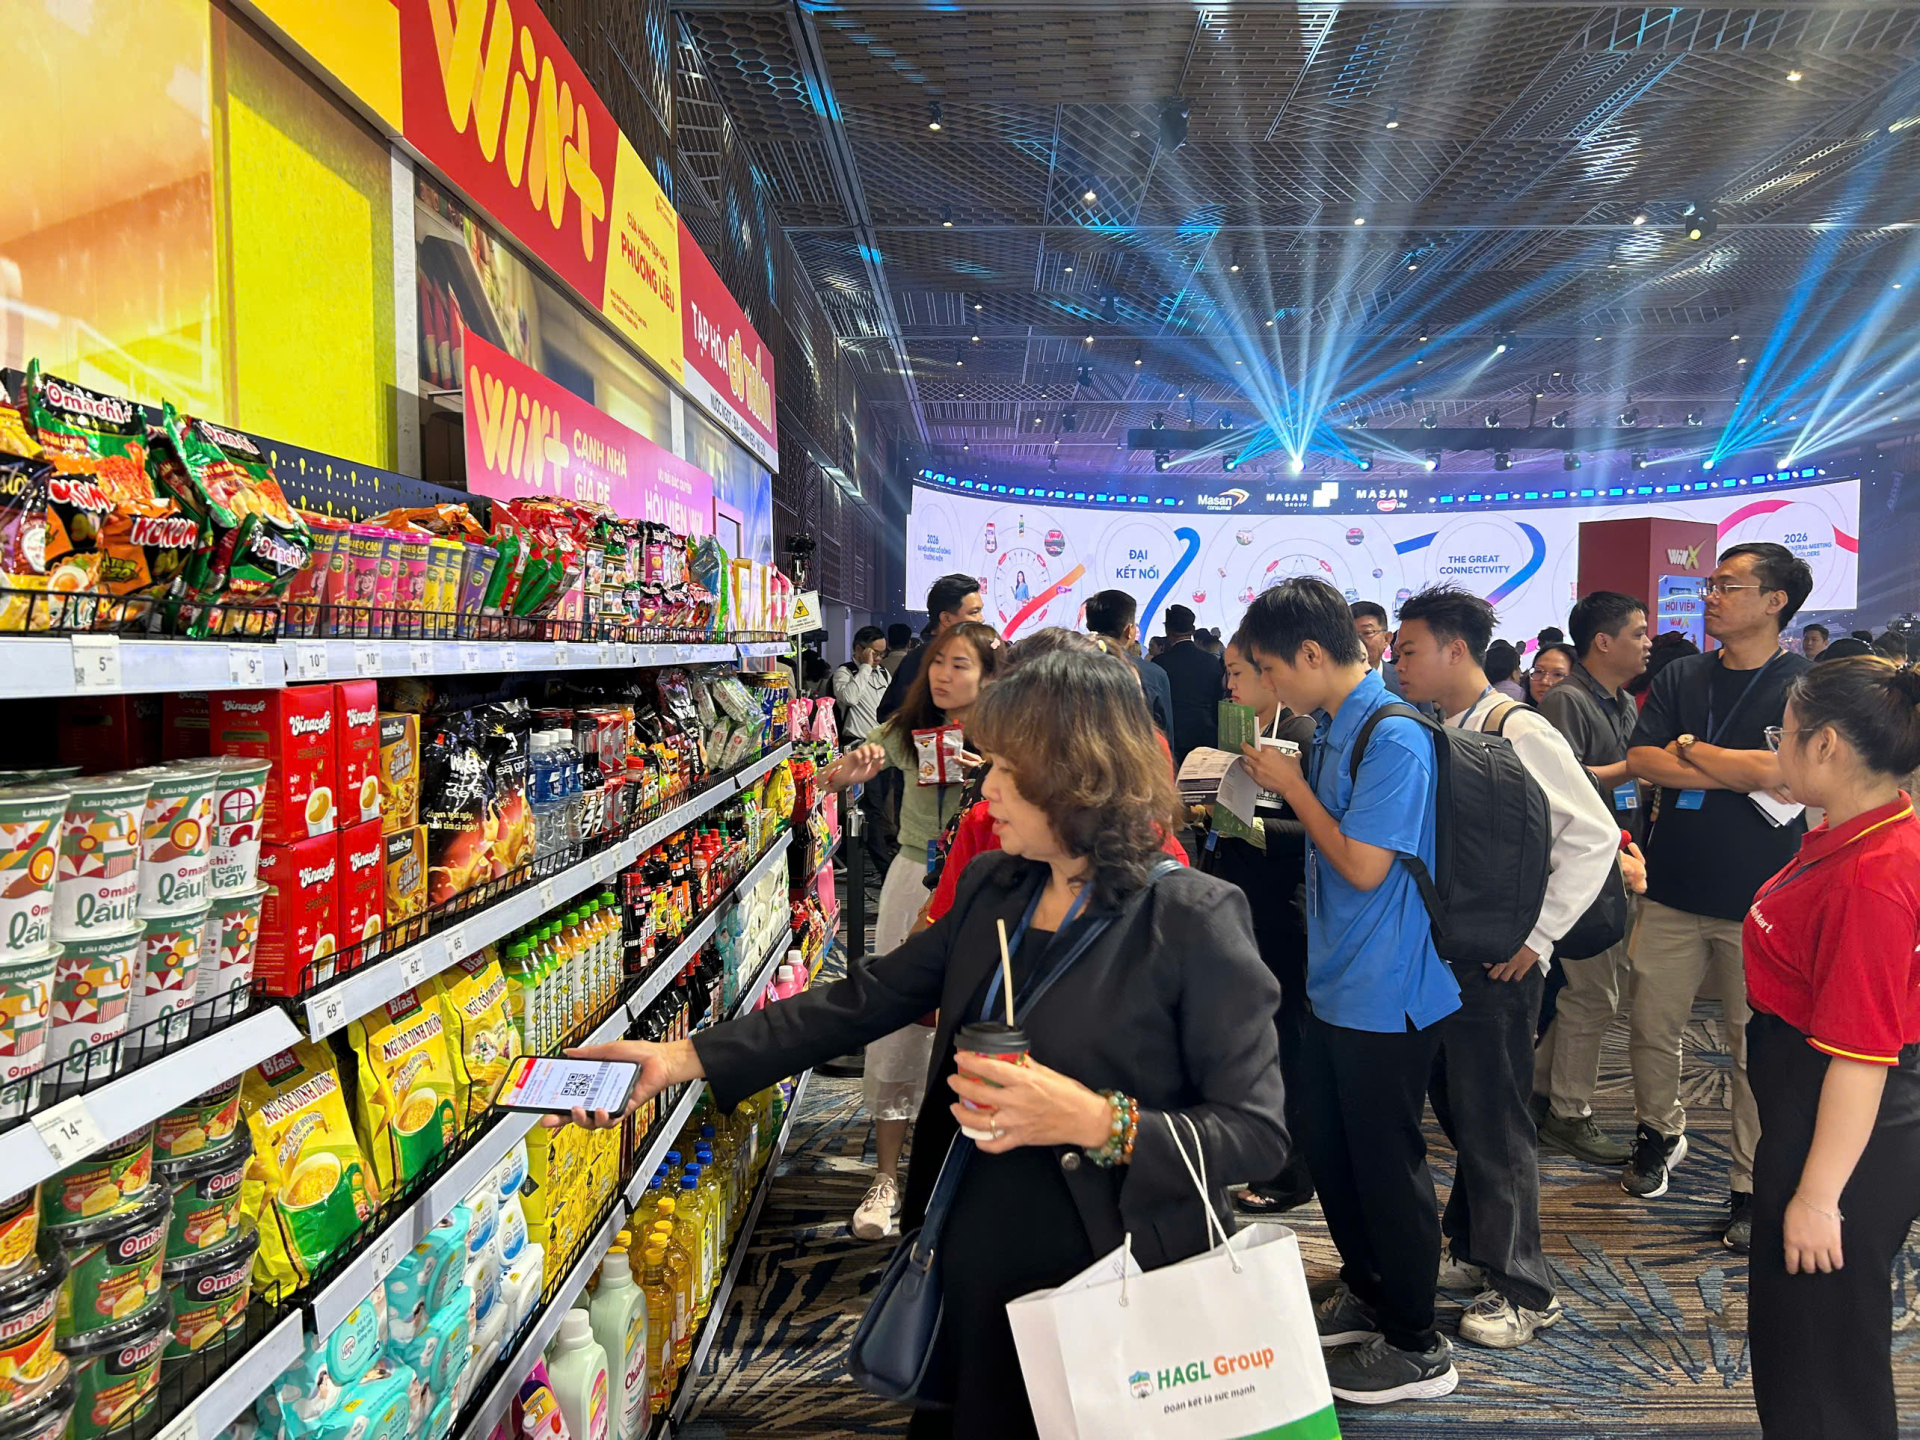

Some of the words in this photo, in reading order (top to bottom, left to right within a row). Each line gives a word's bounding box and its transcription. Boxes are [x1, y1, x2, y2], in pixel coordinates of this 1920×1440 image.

[691, 300, 708, 357] TẠP
[710, 323, 728, 377] HÓA
[47, 382, 125, 424] Omachi
[1198, 494, 1232, 506] Masan
[1356, 490, 1408, 499] MASAN
[1784, 533, 1808, 544] 2026
[1128, 549, 1148, 562] ĐẠI
[1448, 555, 1466, 564] THE
[1468, 554, 1500, 564] GREAT
[1116, 564, 1136, 579] KẾT
[1138, 564, 1160, 580] NỐI
[1440, 564, 1510, 575] CONNECTIVITY
[99, 656, 106, 671] 5
[250, 660, 256, 673] 9
[310, 655, 320, 667] 10
[366, 653, 376, 664] 10
[289, 711, 331, 736] Vinacafé
[347, 704, 376, 728] Vinacafé
[389, 836, 412, 852] wake-up
[350, 844, 380, 872] Vinacafé
[211, 868, 248, 889] tay
[299, 858, 335, 889] Vinacafé
[98, 883, 136, 898] Omach
[157, 873, 201, 906] lẩu
[75, 893, 124, 928] lẩu
[454, 938, 462, 950] 65
[410, 960, 420, 974] 62
[326, 1003, 337, 1018] 69
[60, 1122, 79, 1140] 14
[382, 1247, 389, 1264] 67
[1157, 1360, 1211, 1390] HAGL
[1214, 1347, 1274, 1376] Group
[1164, 1400, 1186, 1414] Đoàn
[1188, 1394, 1203, 1408] kết
[1204, 1392, 1212, 1404] là
[1214, 1388, 1230, 1402] sức
[1230, 1384, 1256, 1400] mạnh
